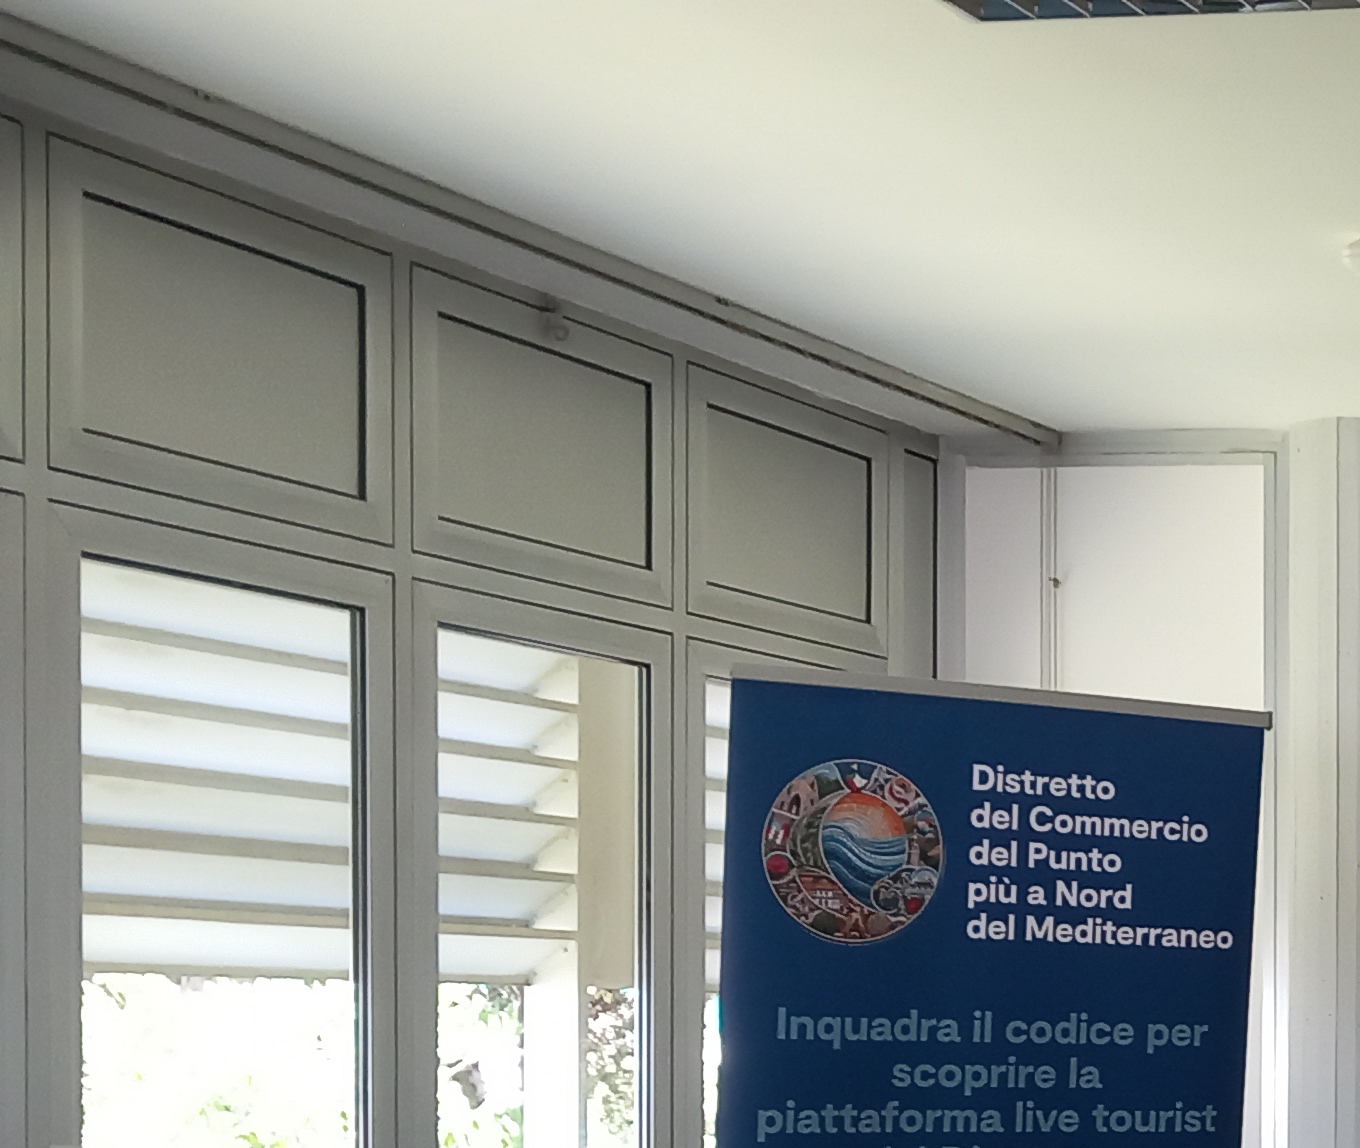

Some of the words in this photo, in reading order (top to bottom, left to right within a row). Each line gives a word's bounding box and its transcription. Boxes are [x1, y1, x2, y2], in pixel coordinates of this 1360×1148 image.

[972, 763, 1116, 801] Distretto
[970, 801, 1019, 831] del
[1029, 805, 1209, 843] Commercio
[968, 838, 1018, 868] del
[1028, 841, 1122, 873] Punto
[967, 875, 1018, 909] più
[1026, 885, 1048, 906] a
[1055, 879, 1133, 910] Nord
[966, 912, 1016, 941] del
[1025, 914, 1233, 949] Mediterraneo
[777, 1006, 962, 1050] Inquadra
[972, 1009, 993, 1043] il
[1005, 1012, 1135, 1046] codice
[1146, 1023, 1209, 1055] per
[890, 1055, 1057, 1097] scoprire
[1068, 1056, 1103, 1089] la
[756, 1099, 1005, 1143] piattaforma
[1015, 1100, 1080, 1133] live
[1091, 1100, 1218, 1133] tourist
